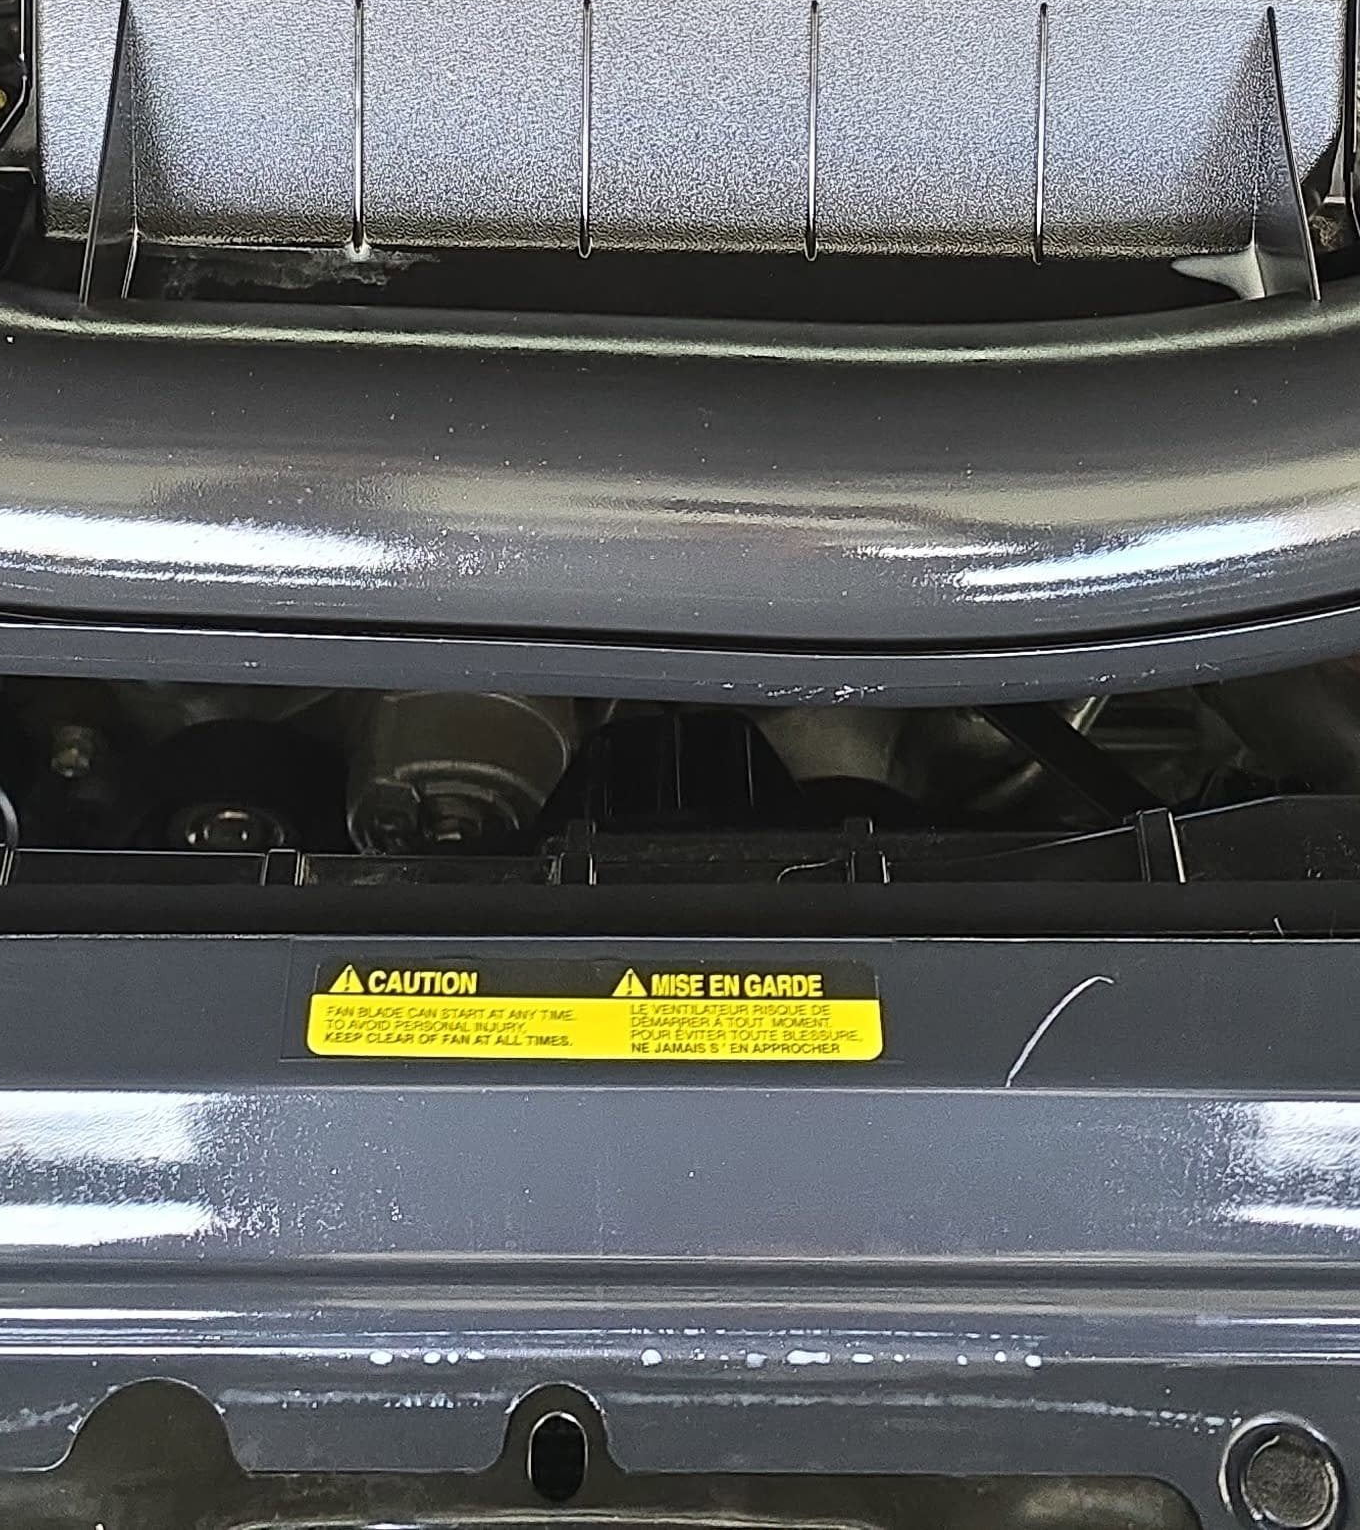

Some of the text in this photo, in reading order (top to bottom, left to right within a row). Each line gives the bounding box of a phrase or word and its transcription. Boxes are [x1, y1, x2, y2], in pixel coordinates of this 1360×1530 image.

[368, 970, 478, 995] CAUTION
[651, 973, 823, 998] MISE EN GARDE
[327, 1006, 354, 1017] FAN
[358, 1006, 404, 1018] BLADE
[408, 1007, 437, 1019] CAN
[441, 1008, 485, 1019] START
[488, 1009, 505, 1019] AT
[509, 1009, 537, 1020] ANY
[631, 1004, 831, 1016] LE VENTILATEUR RISQUE DE
[325, 1019, 345, 1030] TO
[348, 1019, 390, 1031] AVOID
[394, 1020, 470, 1032] PERSONAL
[726, 1017, 764, 1028] TOUT
[325, 1032, 362, 1043] KEEP
[366, 1032, 414, 1044] CLEAR
[418, 1033, 437, 1044] OF
[442, 1034, 470, 1045] FAN
[473, 1035, 491, 1045] AT
[495, 1035, 522, 1046] ALL
[631, 1029, 671, 1041] POUR
[729, 1030, 778, 1041] TOUTE
[631, 1042, 649, 1053] NE
[654, 1042, 706, 1053] JAMAIS
[730, 1042, 749, 1054] EN
[752, 1043, 840, 1054] APPROCHER
